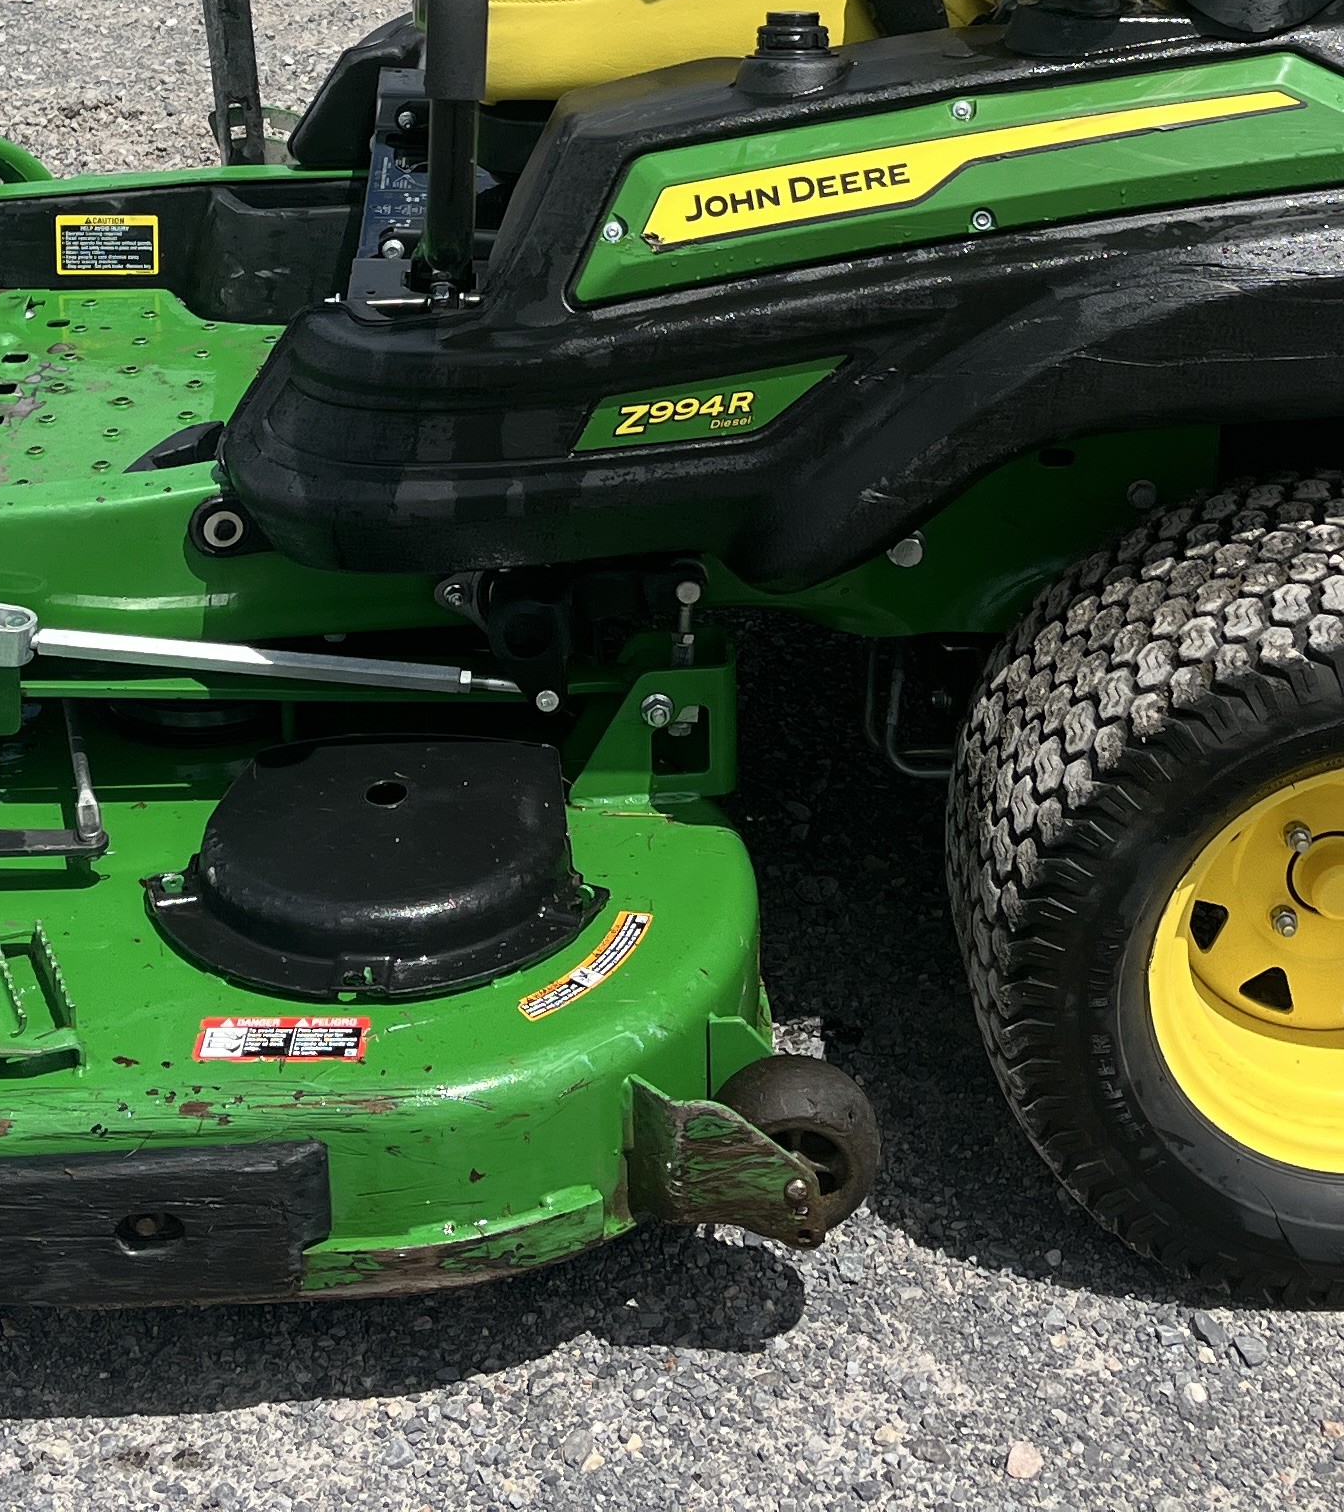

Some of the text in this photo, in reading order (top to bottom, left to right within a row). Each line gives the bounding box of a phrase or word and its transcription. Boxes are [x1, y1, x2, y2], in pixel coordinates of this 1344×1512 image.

[685, 163, 911, 222] JOHN DEERE
[614, 391, 755, 437] Z994R
[709, 415, 752, 430] Diesel
[237, 1018, 280, 1027] DANGER
[312, 1018, 357, 1027] PELIGRO
